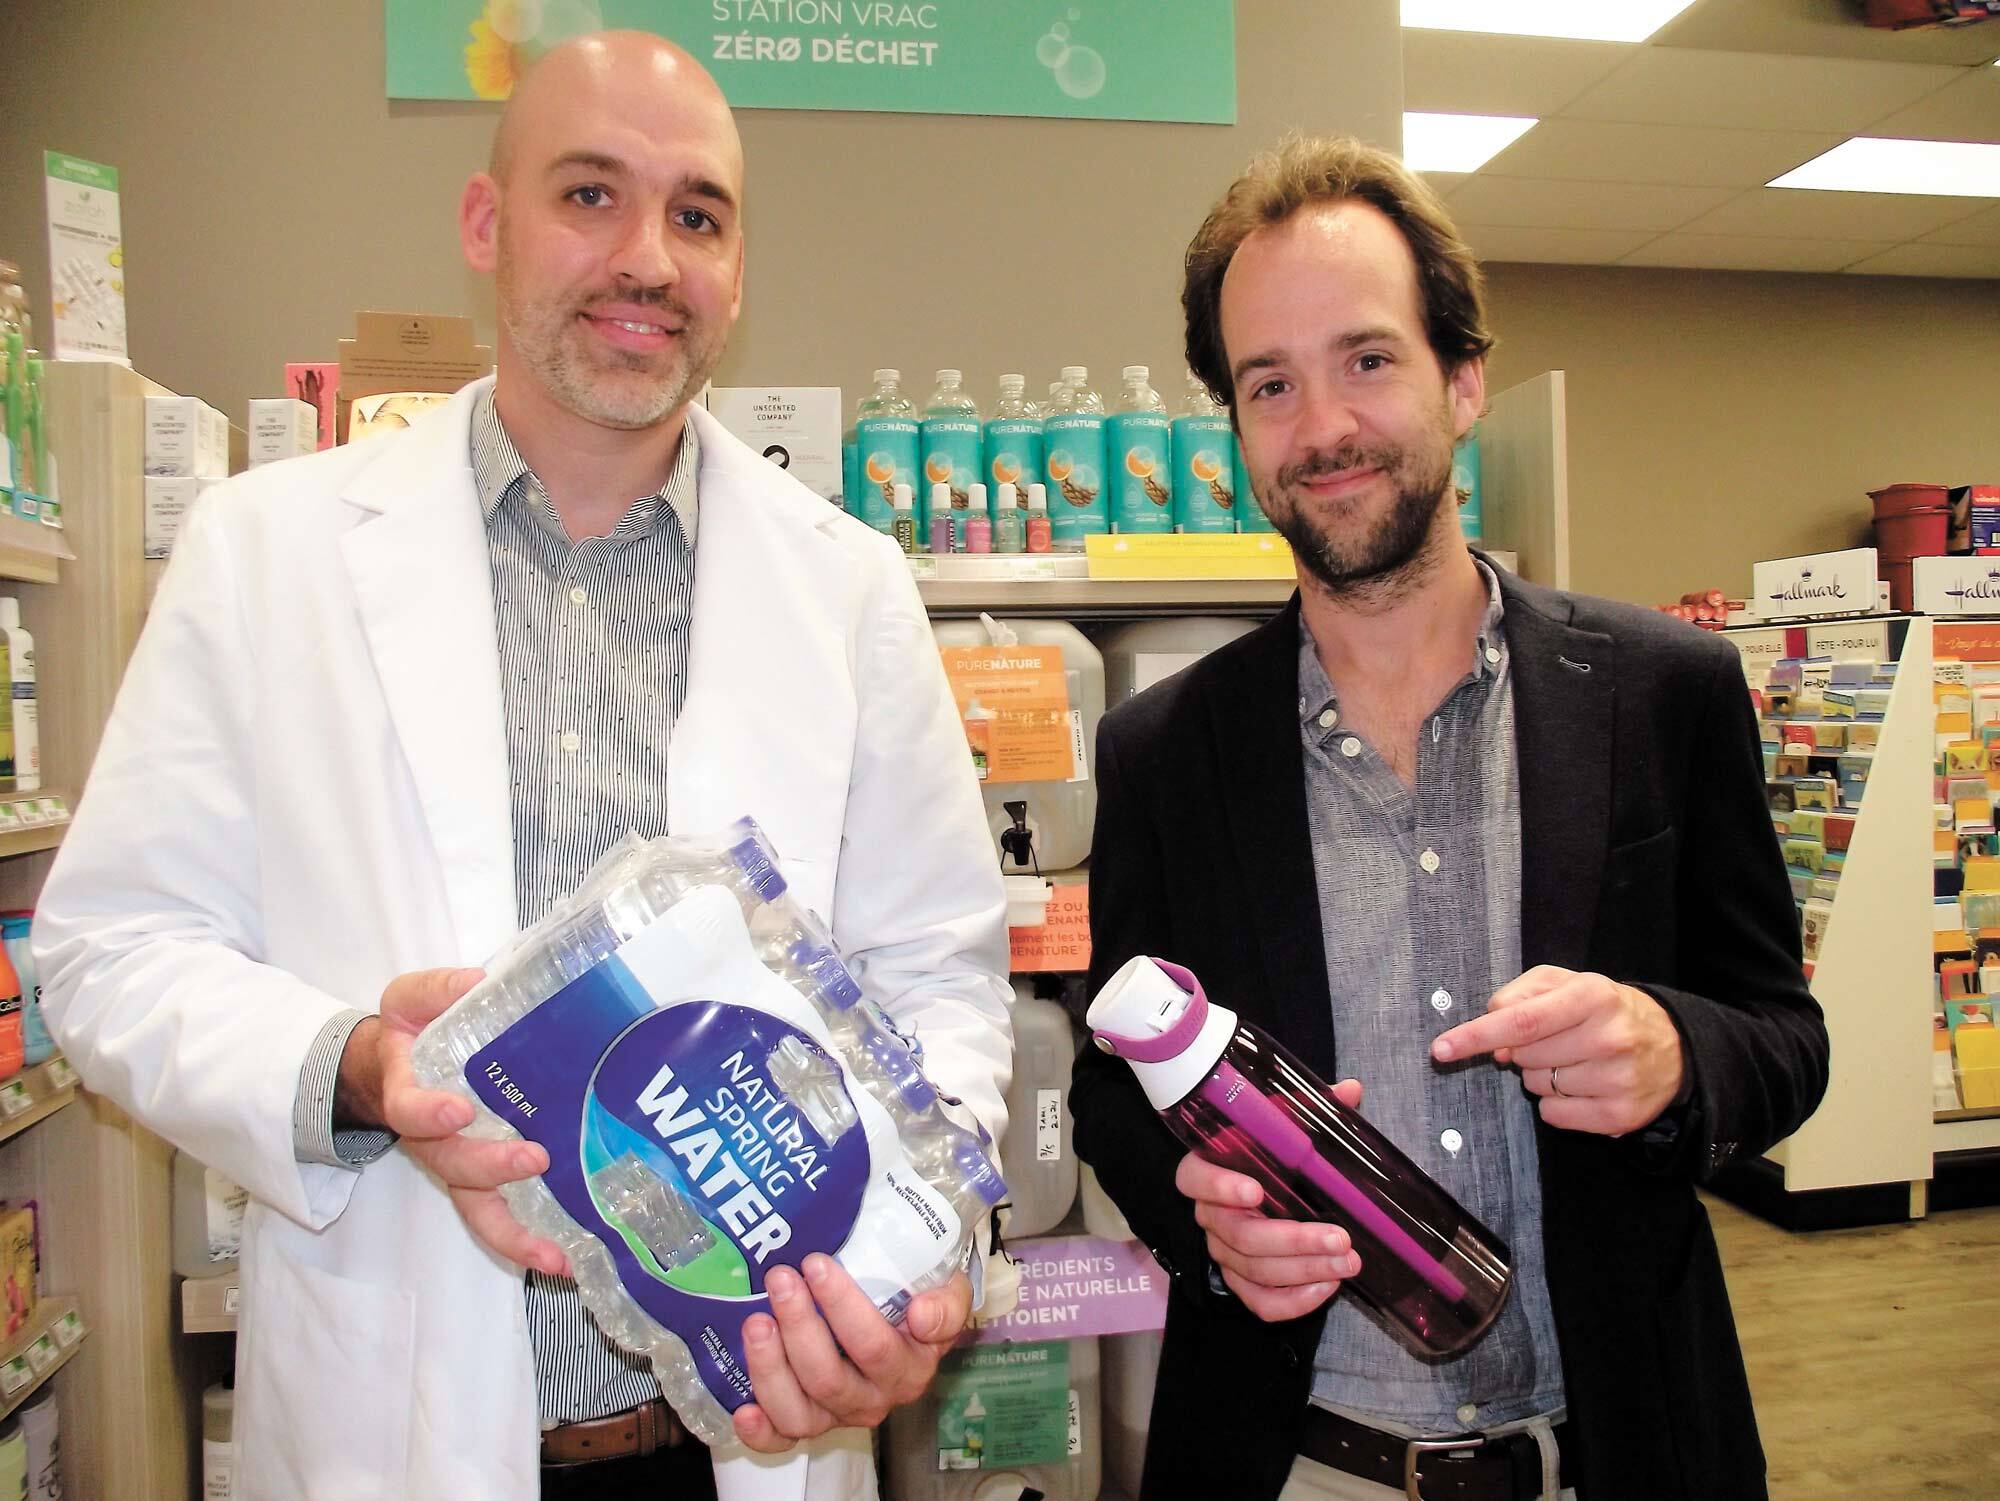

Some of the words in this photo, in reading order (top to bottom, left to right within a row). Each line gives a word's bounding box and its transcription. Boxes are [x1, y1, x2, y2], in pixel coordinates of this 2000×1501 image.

[712, 0, 842, 25] STATION
[851, 3, 938, 29] VRAC
[811, 33, 938, 66] DÉCHET
[753, 404, 796, 412] UNSCENTED
[756, 413, 793, 421] COMPANY
[1769, 574, 1847, 611] Hallmark
[1765, 643, 1782, 653] ELLE
[1842, 638, 1864, 649] POUR
[956, 658, 1041, 671] PURENATURE
[1063, 902, 1083, 912] OU
[1058, 932, 1074, 942] les
[485, 1061, 503, 1079] 12
[501, 1082, 525, 1104] 500
[517, 1101, 538, 1118] mL
[720, 1050, 828, 1192] NATURAL
[704, 1087, 795, 1197] SPRING
[636, 1064, 792, 1265] WATER
[895, 1185, 927, 1217] RECYCLABLE
[924, 1216, 942, 1240] PLASTIC
[904, 1186, 925, 1204] BOTTLE
[923, 1202, 938, 1219] MADE
[935, 1217, 948, 1234] FROM
[1036, 1275, 1151, 1301] NATURELLE
[700, 1332, 720, 1360] FLUORIDE
